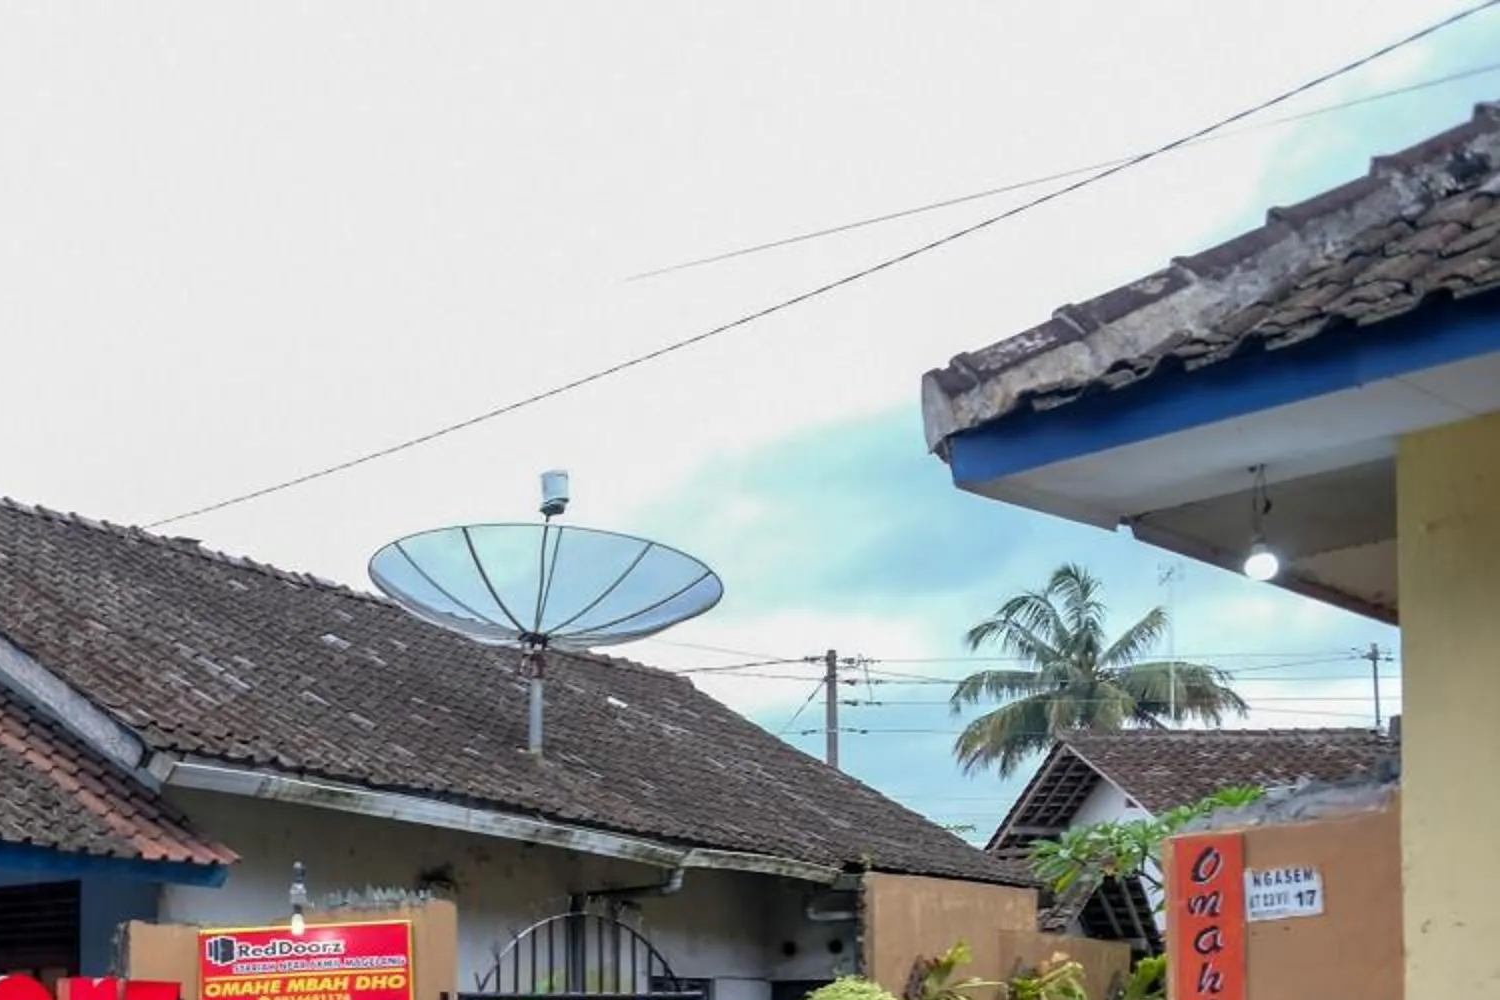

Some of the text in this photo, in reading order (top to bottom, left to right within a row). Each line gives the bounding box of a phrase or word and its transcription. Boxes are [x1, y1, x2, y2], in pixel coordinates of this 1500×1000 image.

[1294, 889, 1317, 907] 17
[236, 939, 345, 959] RedDoorz
[205, 974, 406, 998] OMAHE MBAH DHO
